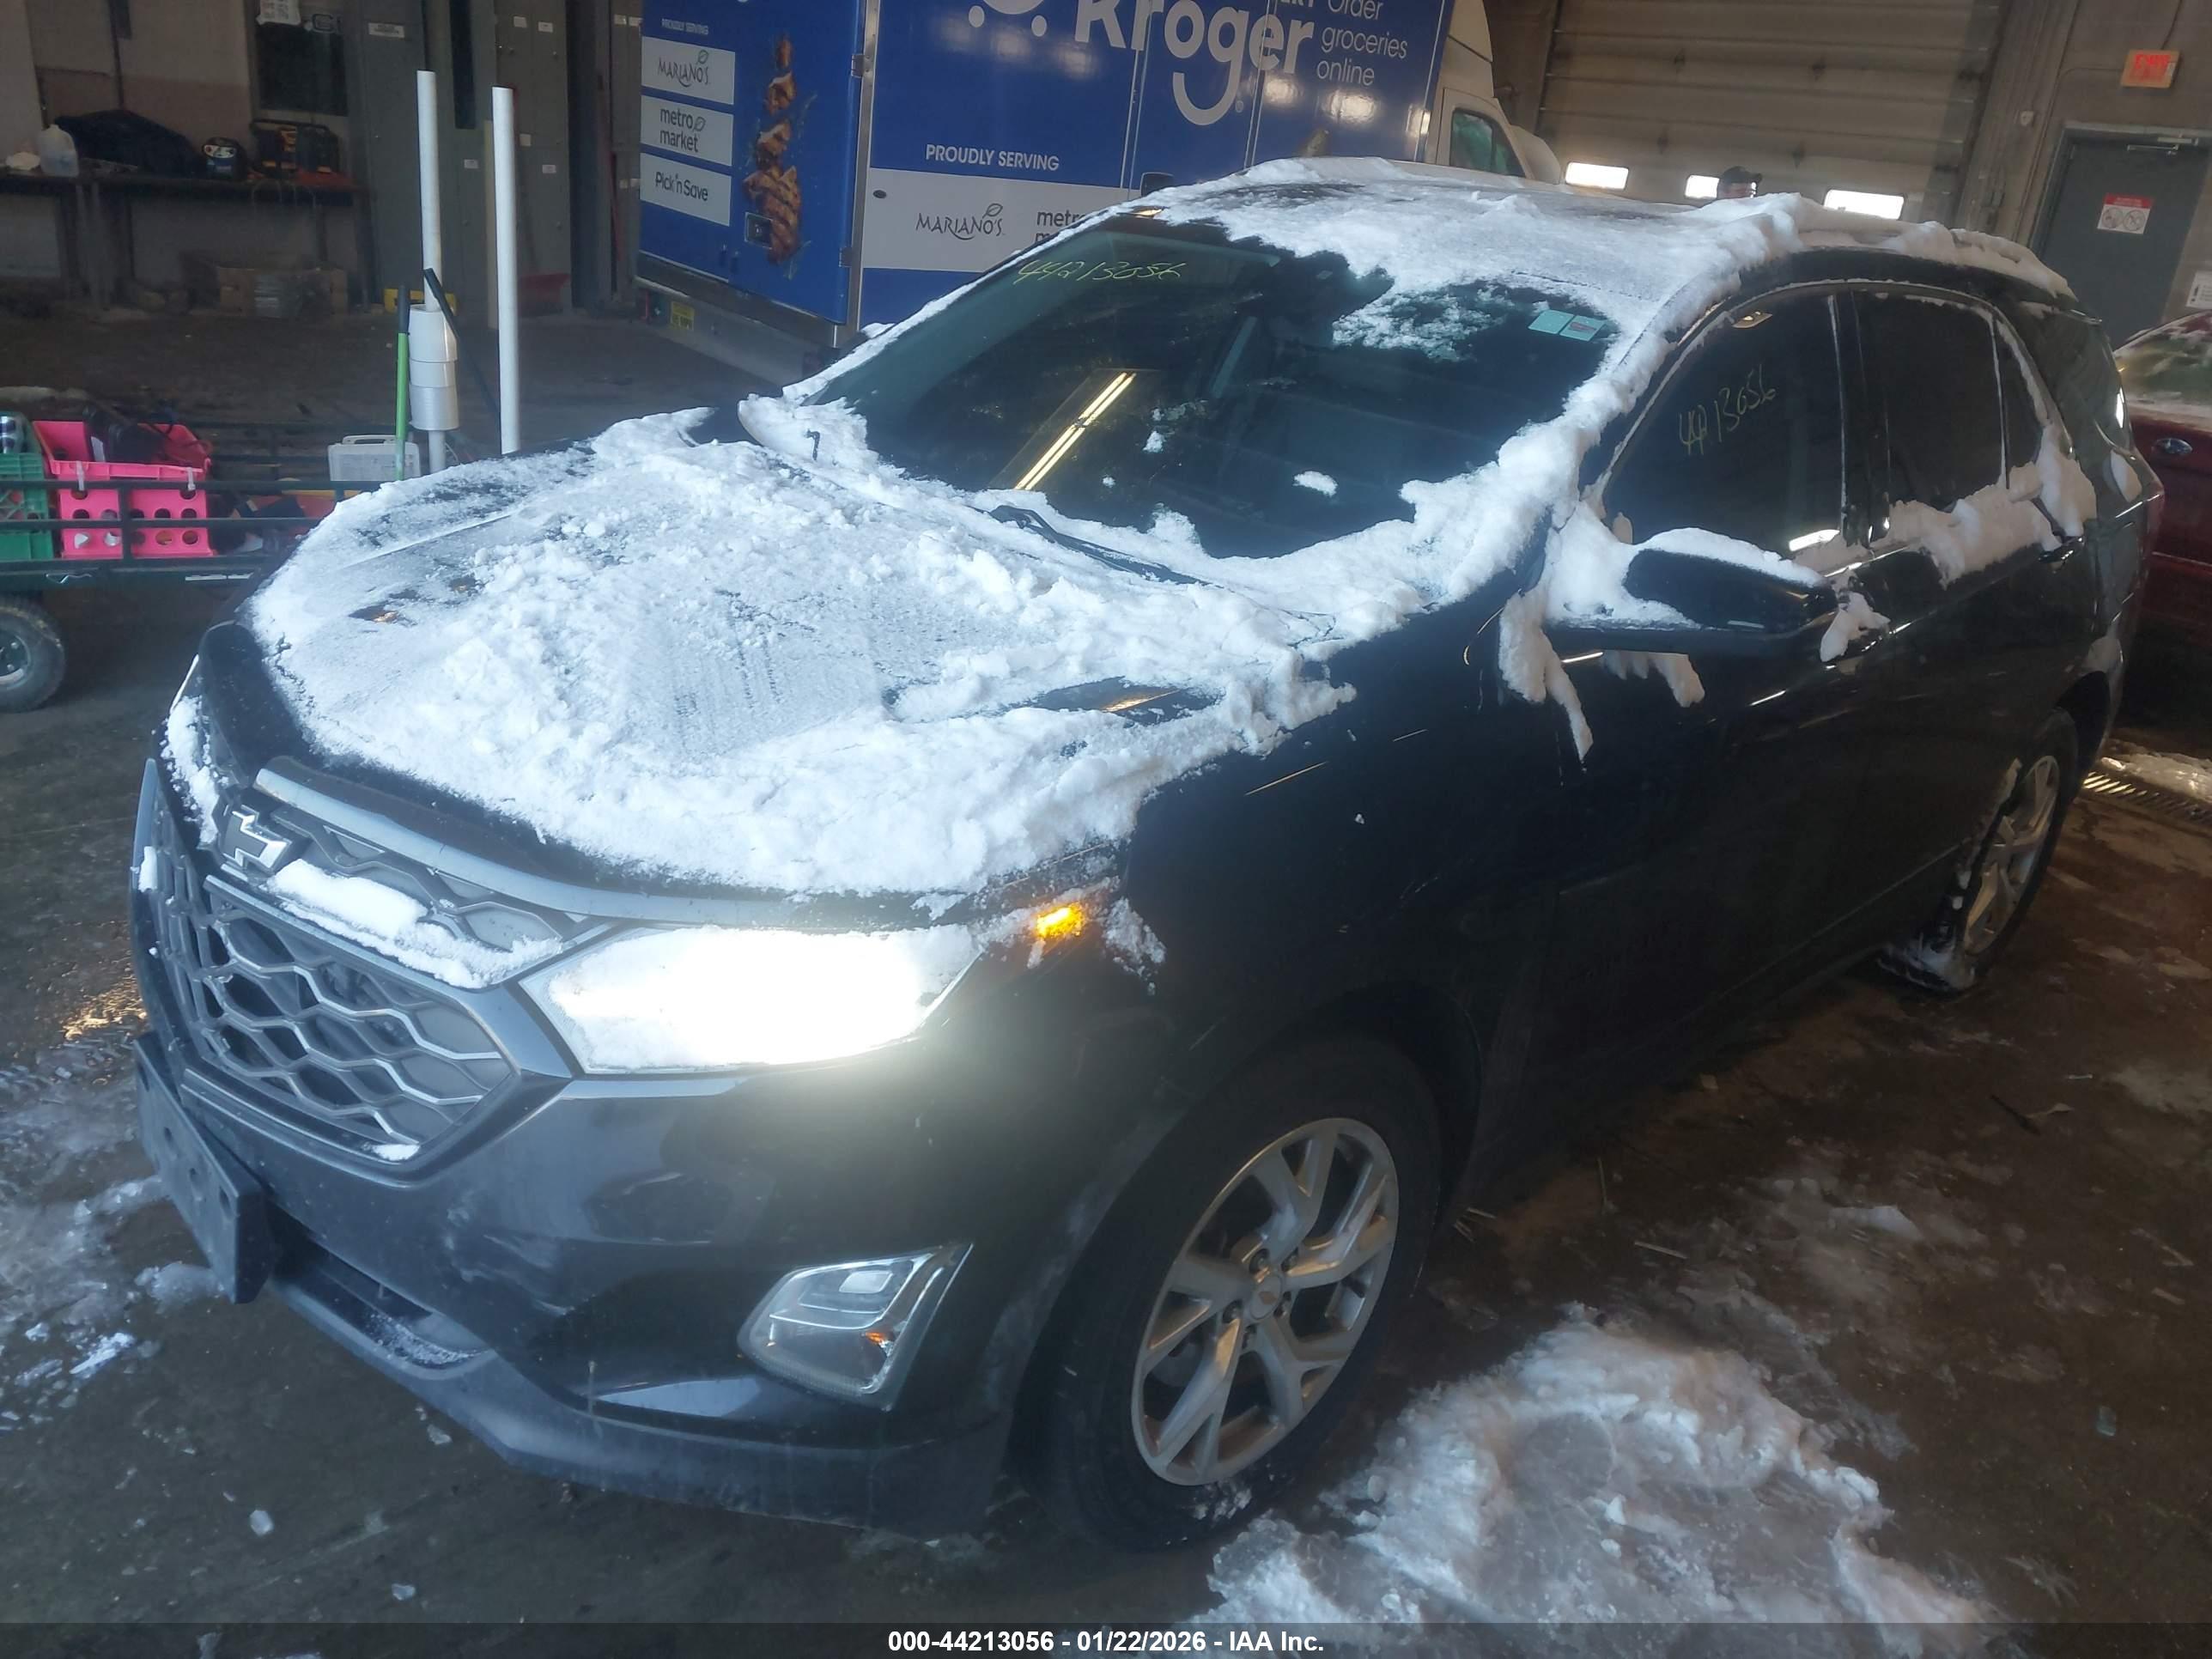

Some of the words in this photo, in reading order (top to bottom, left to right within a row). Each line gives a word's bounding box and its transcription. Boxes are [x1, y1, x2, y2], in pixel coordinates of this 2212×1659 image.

[1321, 27, 1408, 59] groceries
[1074, 0, 1314, 125] Kroger
[1316, 57, 1375, 86] online
[659, 108, 694, 129] metro
[659, 130, 699, 153] market
[926, 143, 994, 166] PROUDLY
[998, 150, 1060, 171] SERVING
[915, 213, 1003, 240] MARIANO'S
